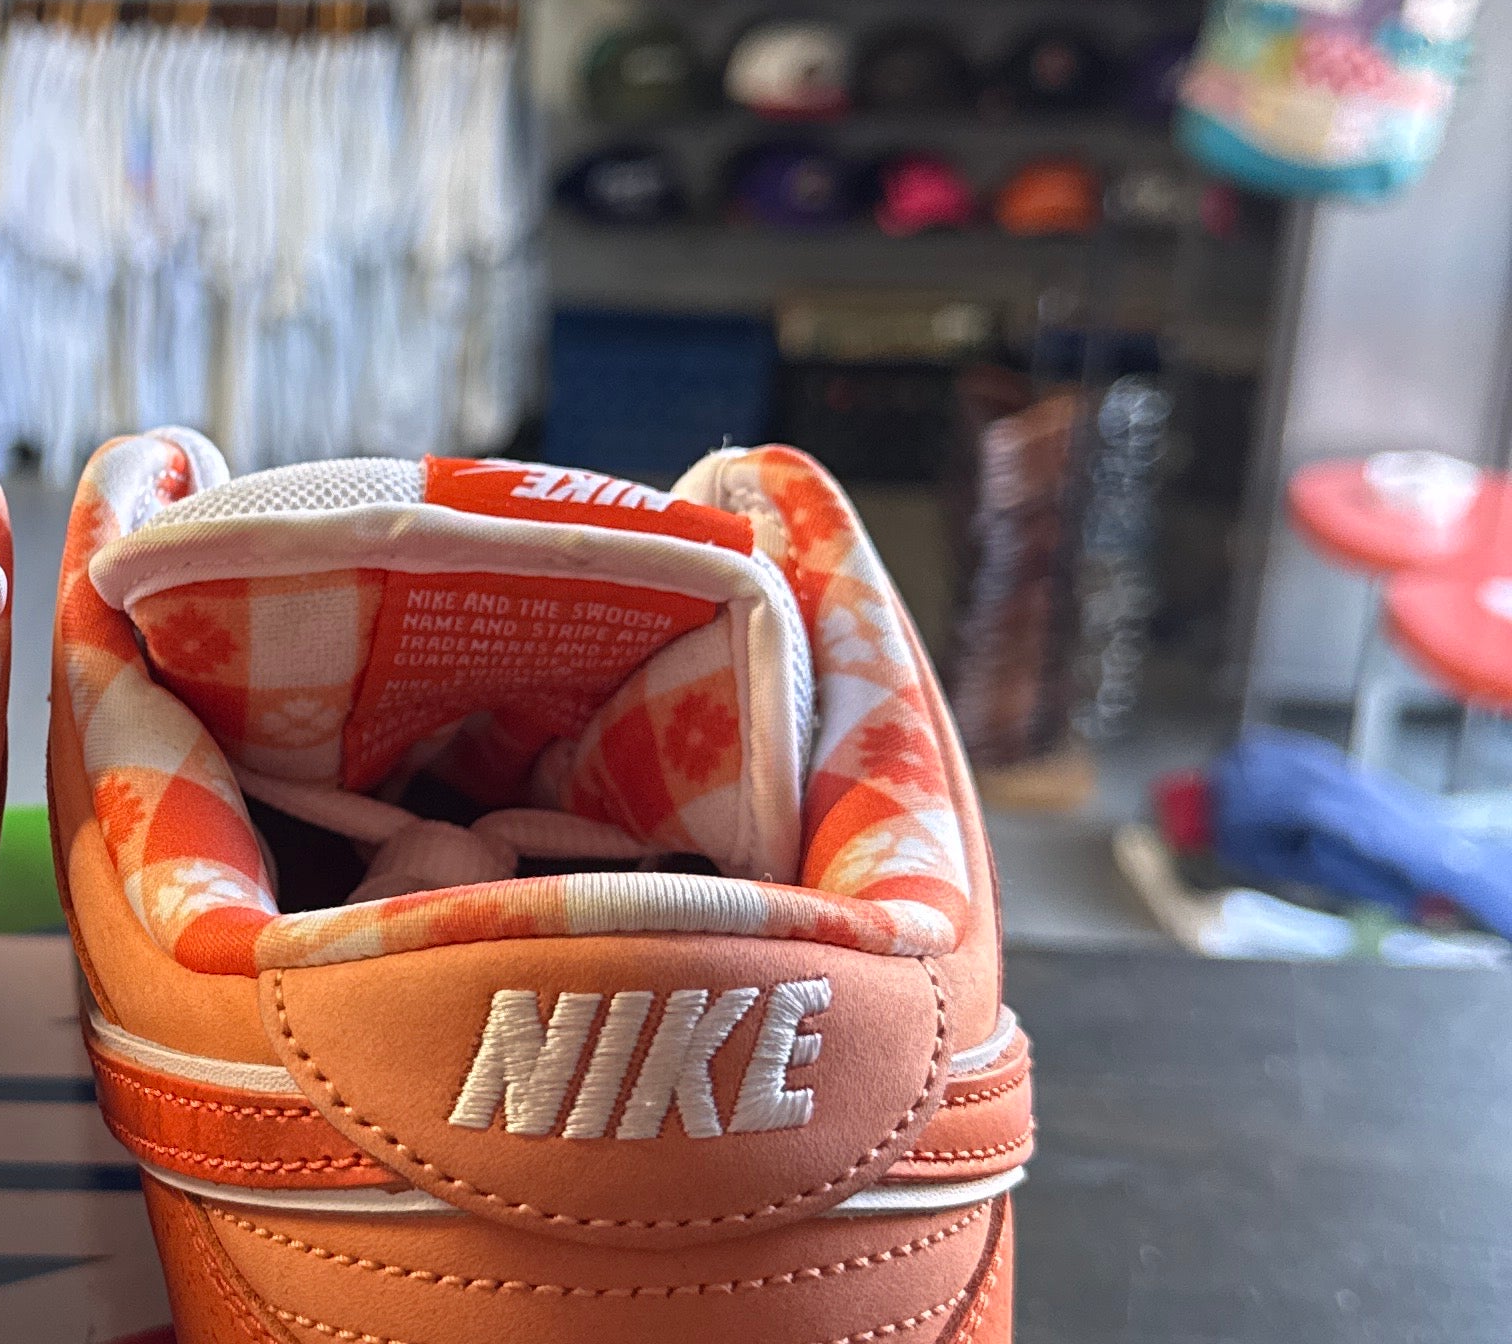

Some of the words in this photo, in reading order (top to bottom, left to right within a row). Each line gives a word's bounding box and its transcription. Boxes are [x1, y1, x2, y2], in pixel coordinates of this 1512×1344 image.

[407, 589, 458, 610] NIKE
[463, 592, 511, 615] AND
[519, 598, 560, 619] THE
[571, 602, 673, 630] SWOOSH
[398, 635, 548, 654] TRADEMARKS
[403, 614, 464, 632] NAME
[470, 618, 518, 636] AND
[531, 622, 609, 641] STRIPE
[448, 977, 833, 1139] NIKE
